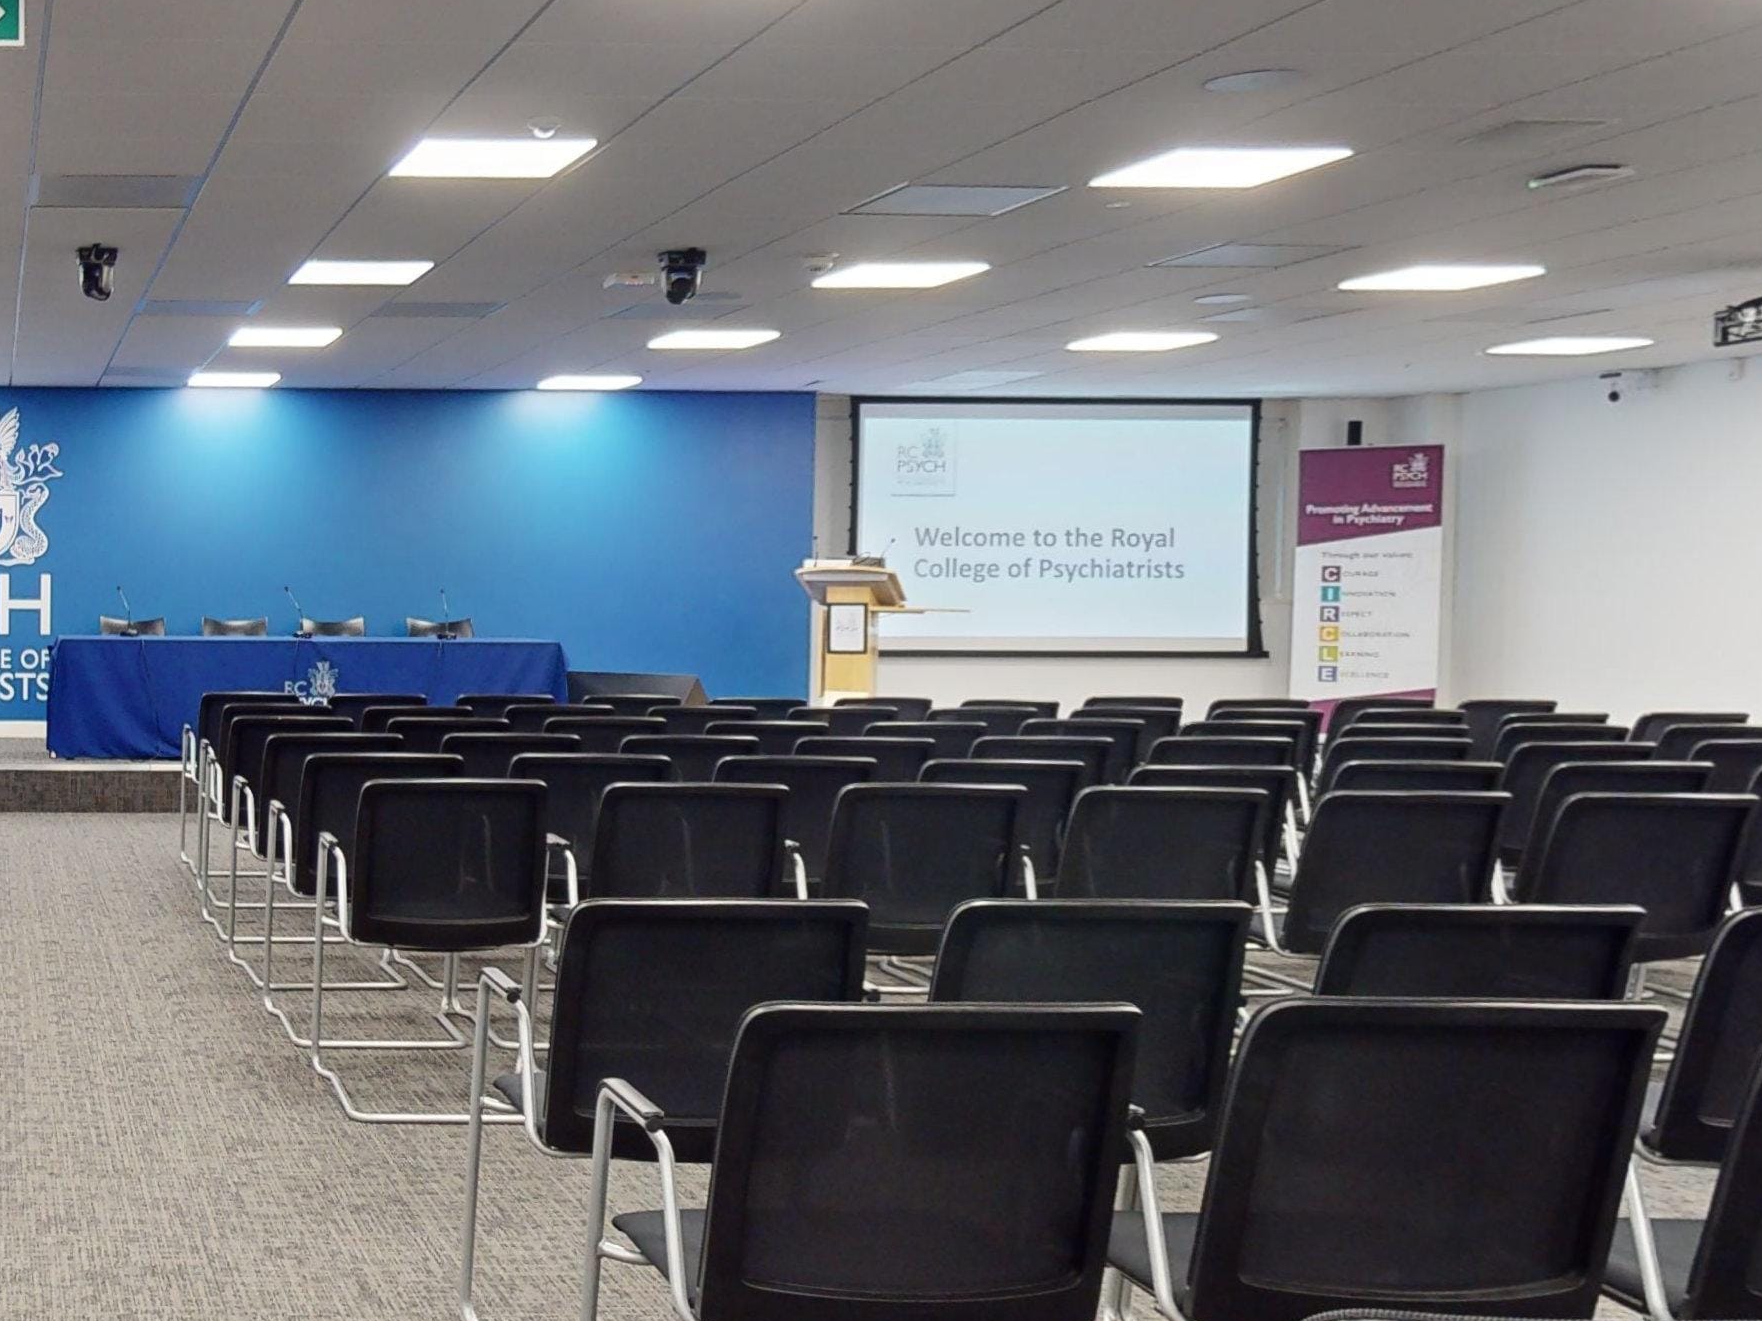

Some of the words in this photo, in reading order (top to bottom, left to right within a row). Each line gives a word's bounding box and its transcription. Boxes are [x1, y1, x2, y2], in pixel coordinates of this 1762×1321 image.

[897, 445, 918, 459] RC
[897, 460, 946, 473] PSYCH
[1305, 503, 1359, 516] Promoting
[1346, 514, 1404, 526] Psychiatry
[914, 526, 1025, 548] Welcome
[1032, 530, 1057, 548] to
[1064, 526, 1103, 548] the
[1110, 526, 1175, 554] Royal
[914, 558, 1000, 585] College
[1007, 557, 1033, 580] of
[1039, 558, 1185, 585] Psychiatrists
[20, 647, 51, 669] OF
[284, 680, 307, 696] RC
